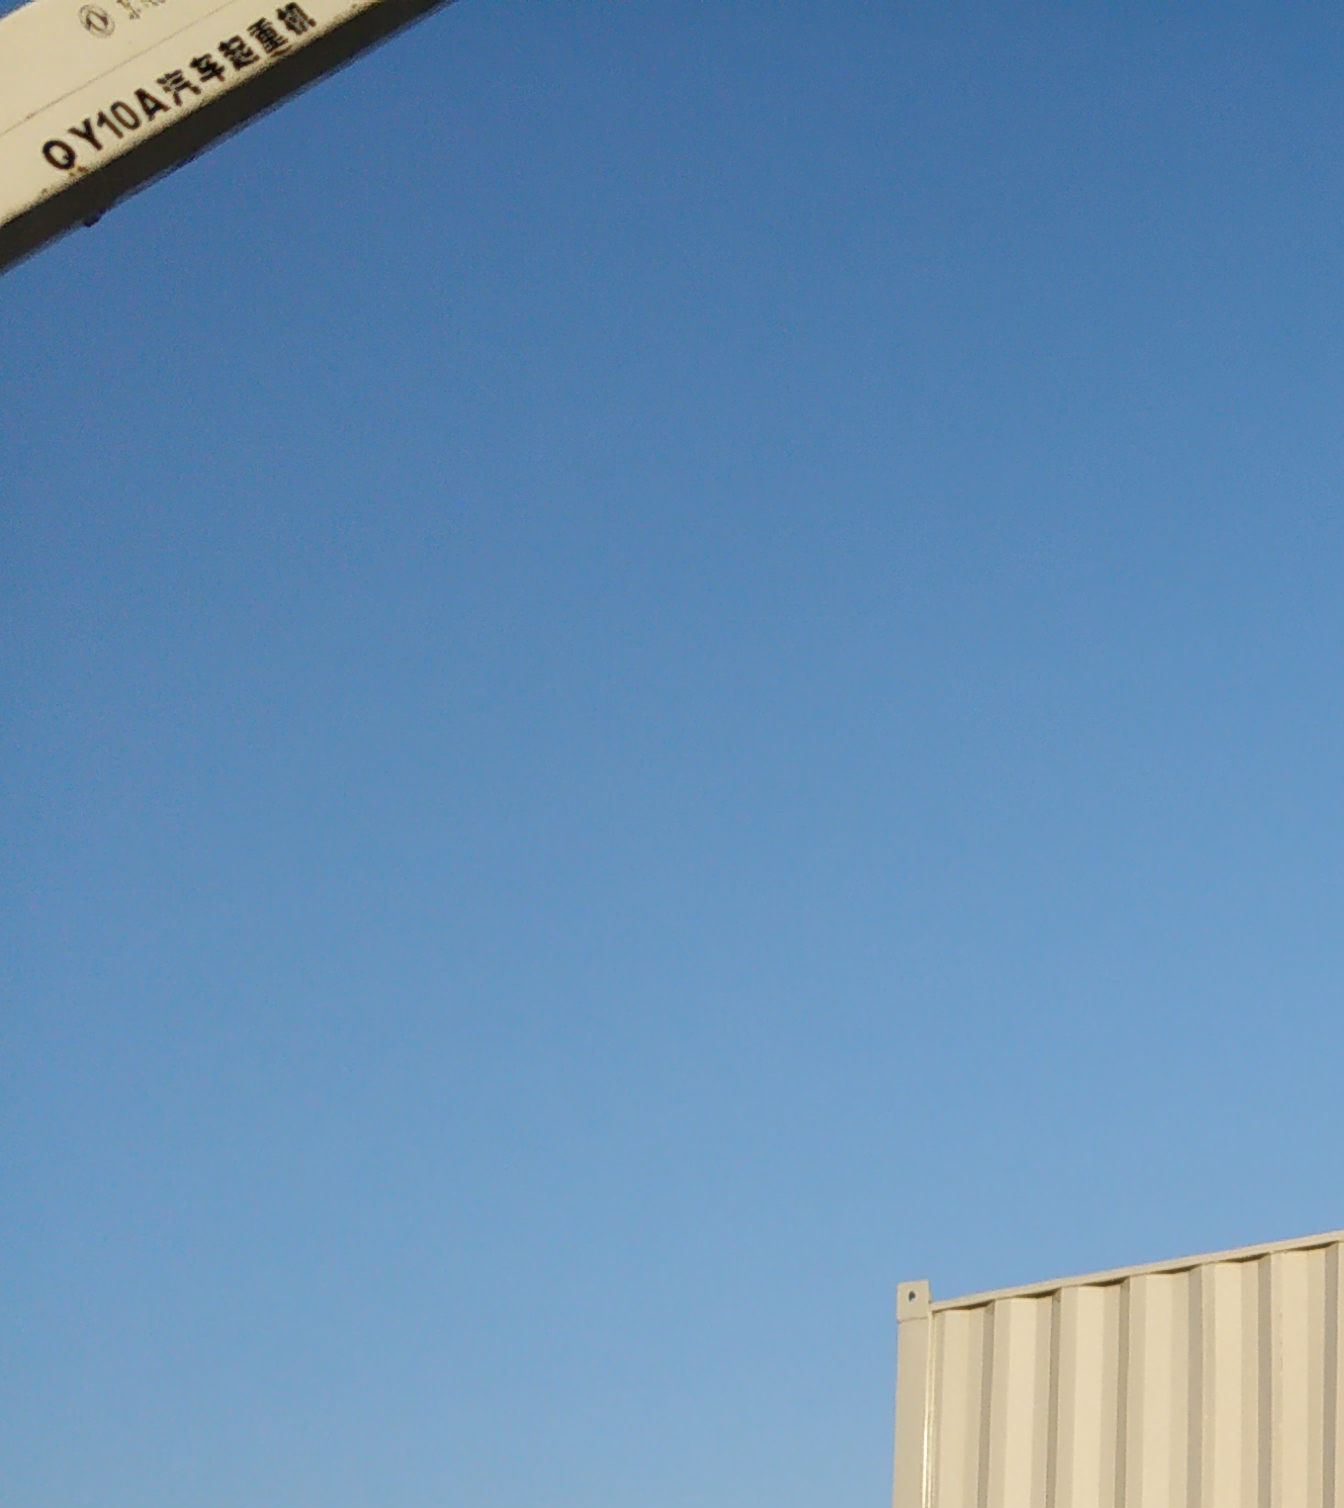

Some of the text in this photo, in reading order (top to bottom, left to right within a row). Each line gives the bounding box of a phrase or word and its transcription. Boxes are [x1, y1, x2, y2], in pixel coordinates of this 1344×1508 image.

[41, 2, 317, 171] QY10A汽车起重机
